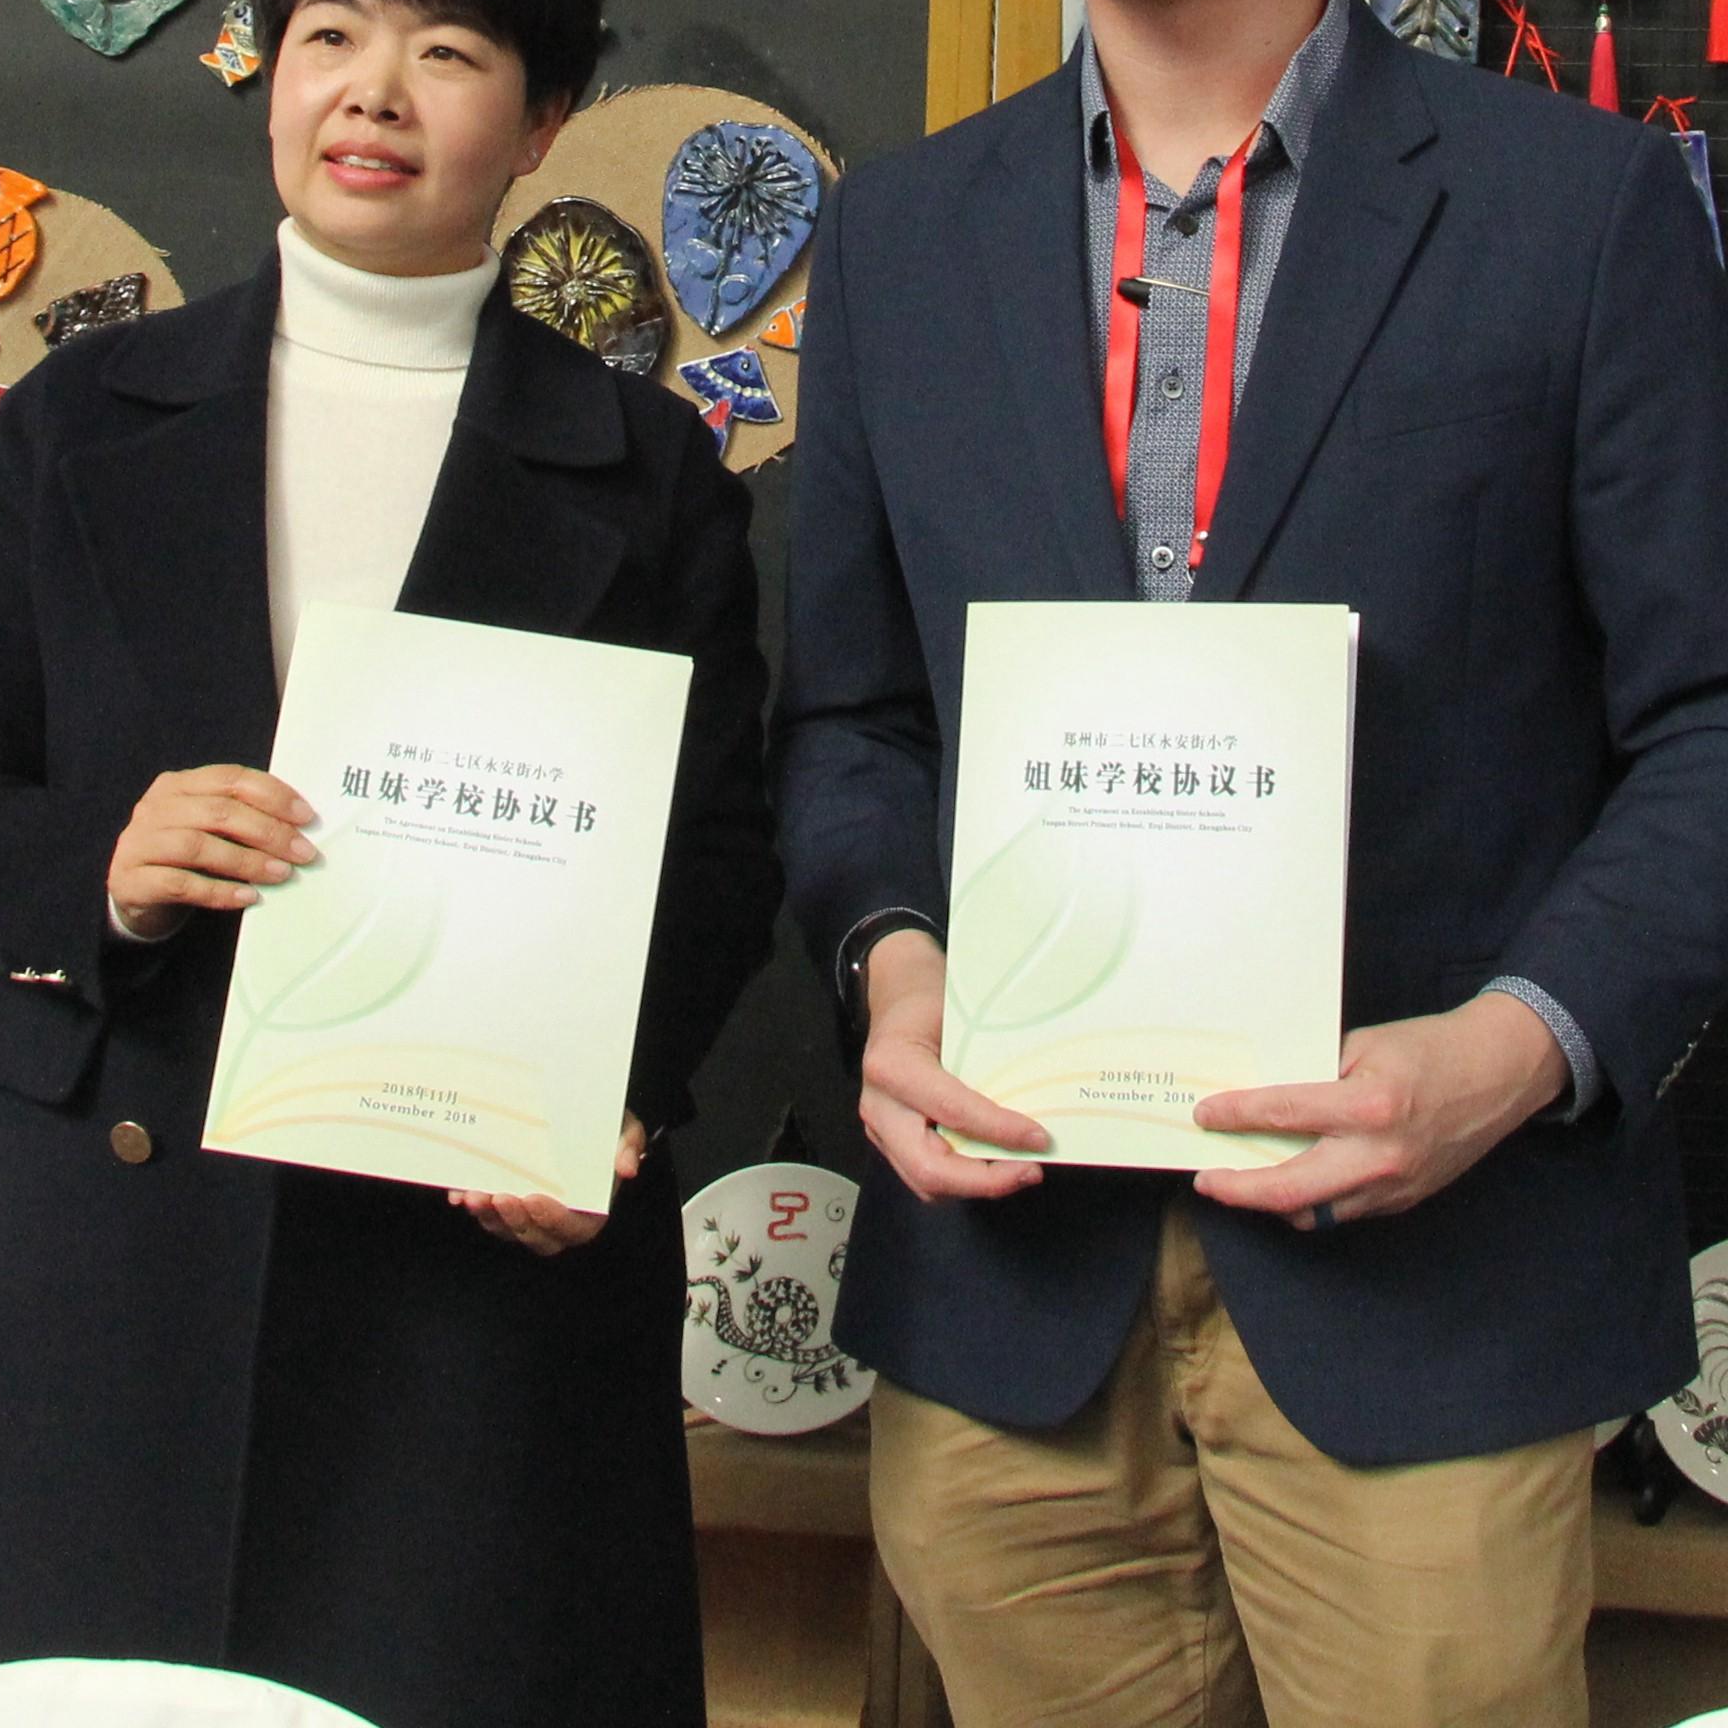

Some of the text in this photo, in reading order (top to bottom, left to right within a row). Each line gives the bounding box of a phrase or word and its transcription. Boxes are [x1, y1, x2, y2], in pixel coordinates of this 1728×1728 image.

[1063, 732, 1238, 751] 郑州市二七区永安街小学
[387, 742, 565, 783] 郑州市二七区永安街小学
[1024, 759, 1276, 798] 姐妹学校协议书
[340, 765, 597, 833] 姐妹学校协议书
[1068, 806, 1081, 814] The
[1083, 807, 1119, 815] Agreement
[1131, 808, 1174, 817] Establishing
[1198, 809, 1226, 817] Schools
[384, 816, 397, 825] The
[399, 819, 436, 831] Agreement
[448, 826, 491, 840] Establishing
[515, 836, 542, 847] Schools
[1068, 819, 1088, 827] Street
[1090, 819, 1117, 829] Primary
[1237, 824, 1253, 833] City
[382, 830, 403, 840] Street
[405, 833, 432, 845] Primary
[552, 856, 567, 866] City
[1100, 1071, 1174, 1086] 2018年11月
[382, 1082, 458, 1105] 2018年11月
[1079, 1087, 1195, 1103] November 2018
[359, 1095, 477, 1124] November 2018
